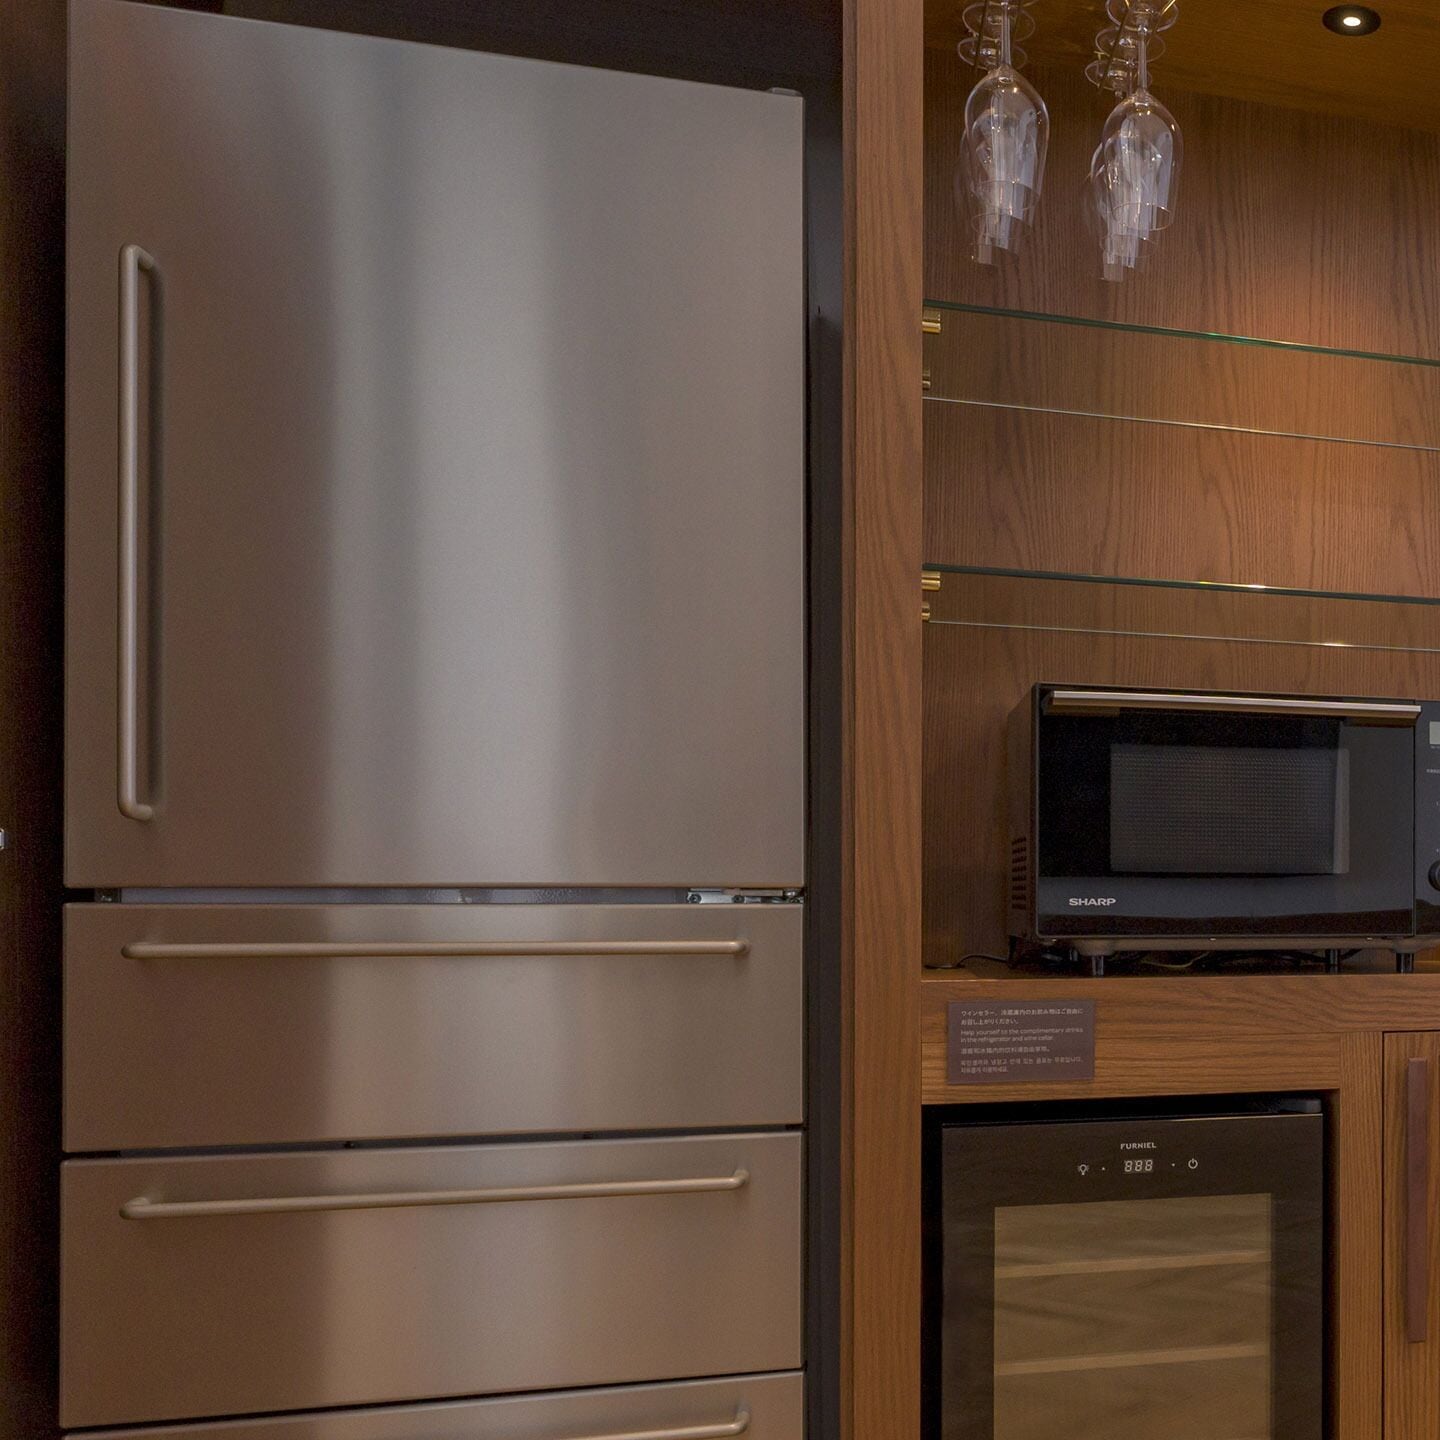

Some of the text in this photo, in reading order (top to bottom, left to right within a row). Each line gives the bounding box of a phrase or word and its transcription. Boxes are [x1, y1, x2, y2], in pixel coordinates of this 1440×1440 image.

[1069, 898, 1117, 906] SHARP
[1120, 1142, 1157, 1150] FURNIEL
[1124, 1159, 1153, 1173] 888
